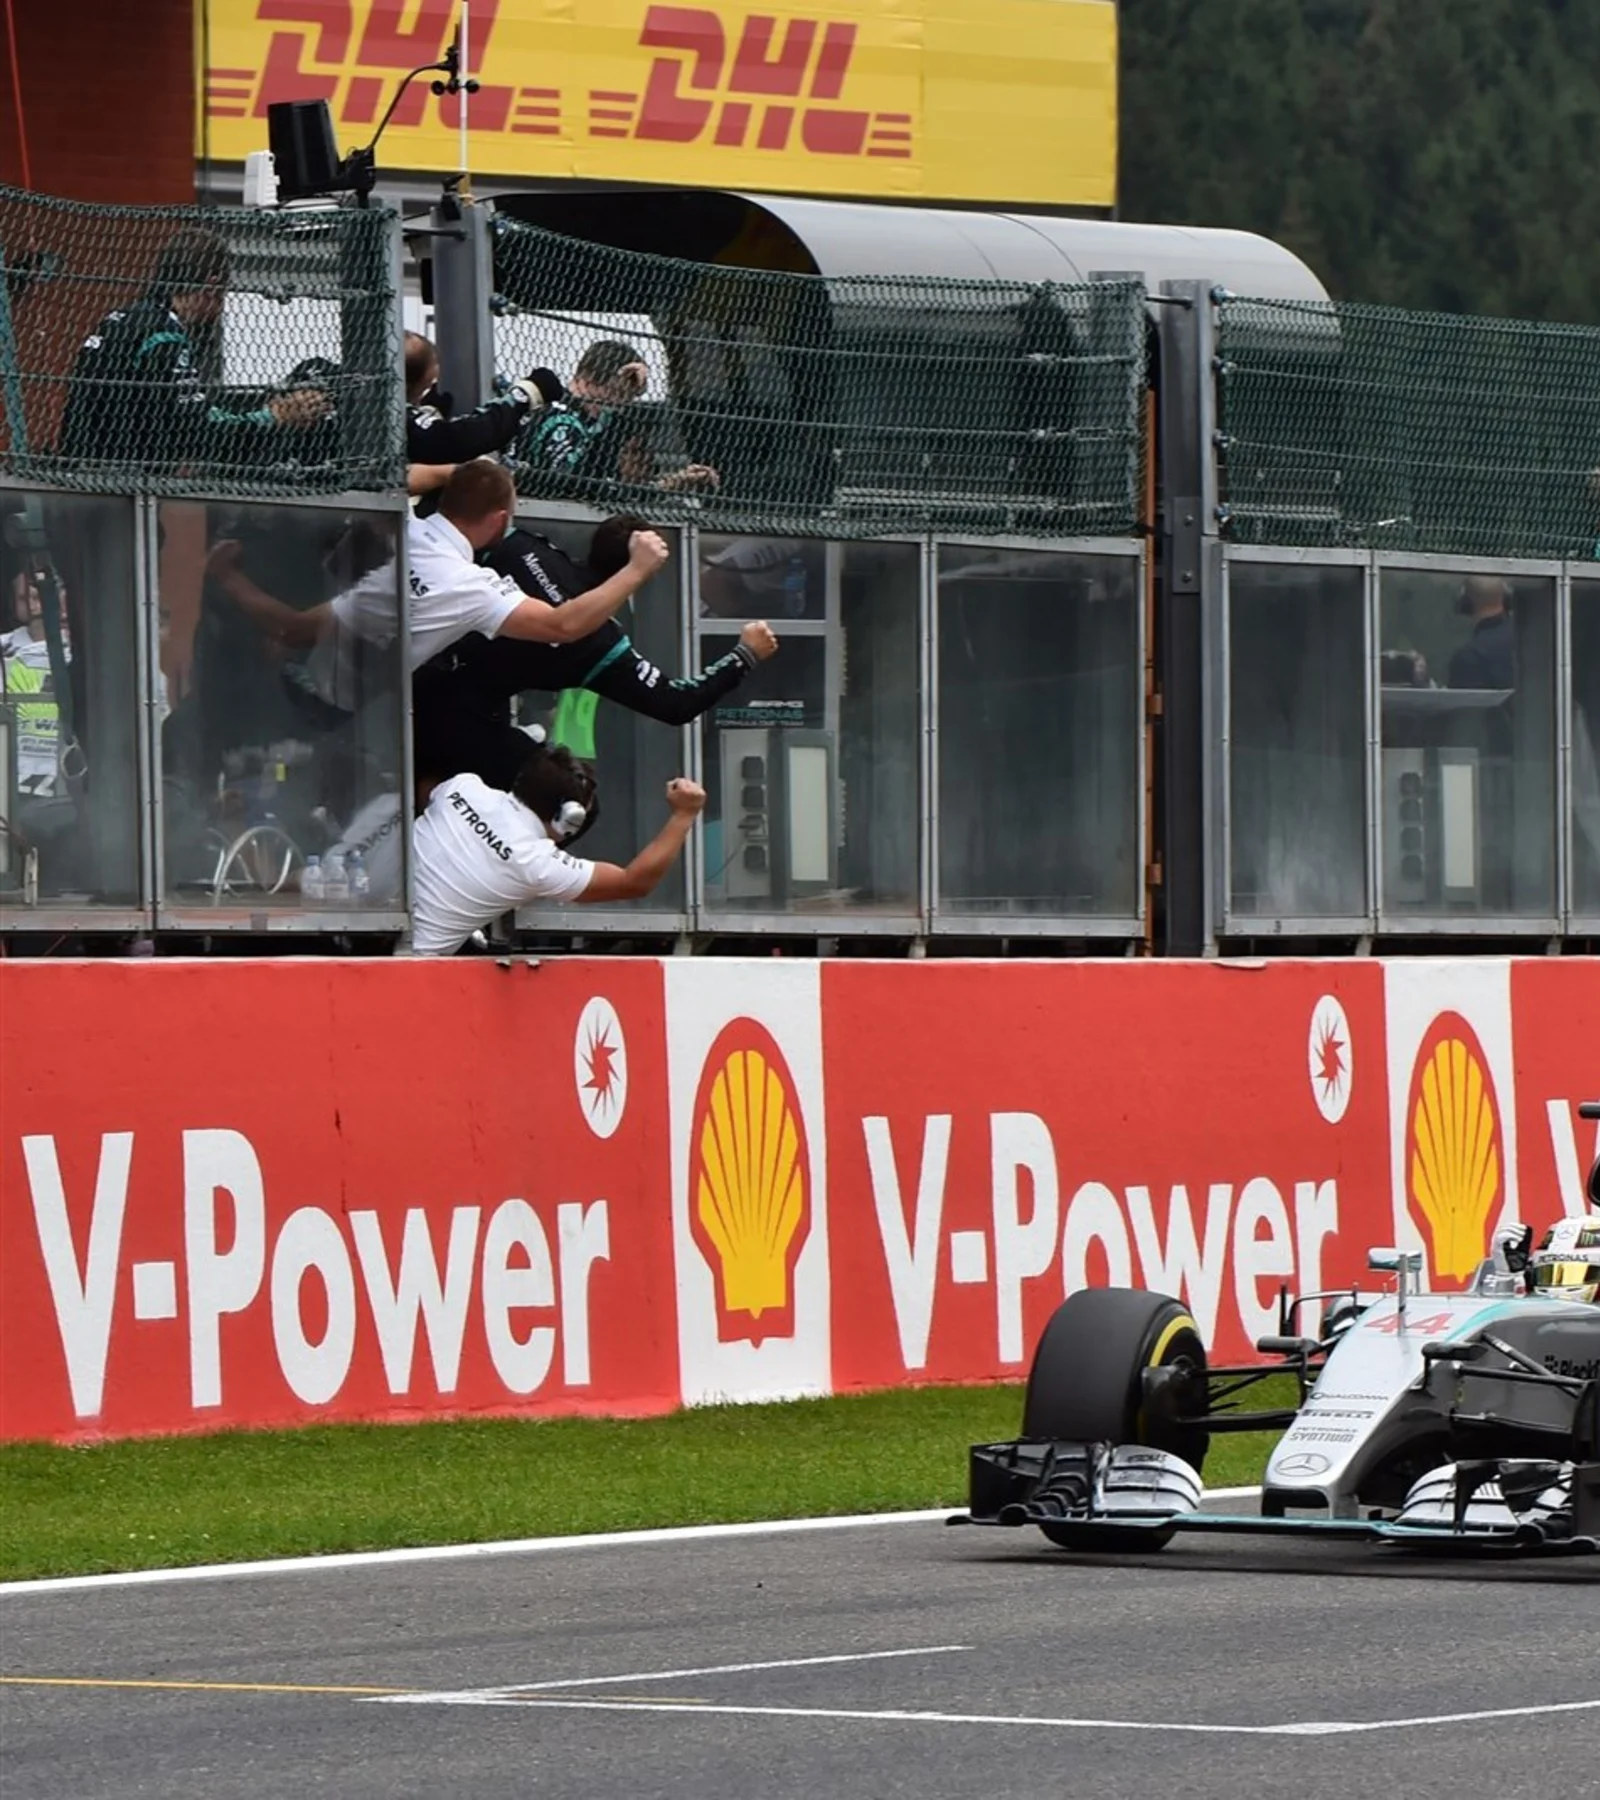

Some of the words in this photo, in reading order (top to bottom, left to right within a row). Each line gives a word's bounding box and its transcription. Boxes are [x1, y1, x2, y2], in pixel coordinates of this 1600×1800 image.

[251, 0, 515, 132] DHL
[633, 4, 871, 156] DHL
[523, 551, 564, 603] Mercedes
[448, 791, 513, 861] PETRONAS
[21, 1128, 610, 1416] V-Power
[861, 1112, 1339, 1370] V-Power
[1538, 1253, 1589, 1263] PETRONAS
[1364, 1312, 1455, 1334] 44
[1289, 1432, 1355, 1443] SYNTIUM
